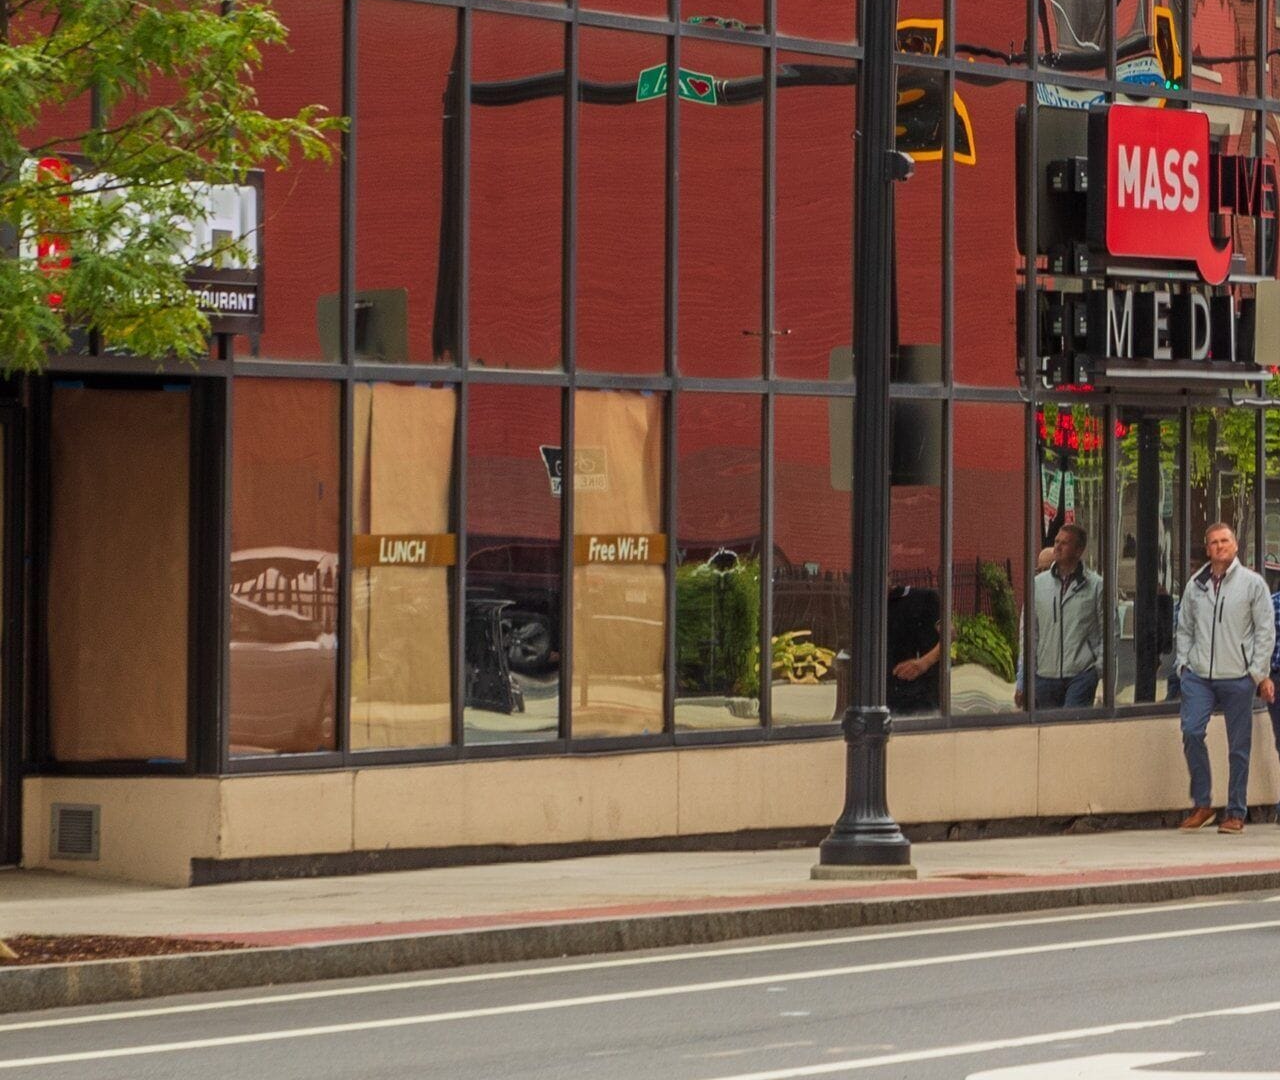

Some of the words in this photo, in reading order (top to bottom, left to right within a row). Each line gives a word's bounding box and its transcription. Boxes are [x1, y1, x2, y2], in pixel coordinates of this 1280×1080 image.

[1117, 143, 1200, 213] MASS
[1217, 153, 1277, 219] LIVE
[1106, 287, 1237, 362] MEDI
[379, 537, 426, 563] LUNCH
[589, 537, 615, 561] Free
[617, 537, 649, 561] Wi-Fi
